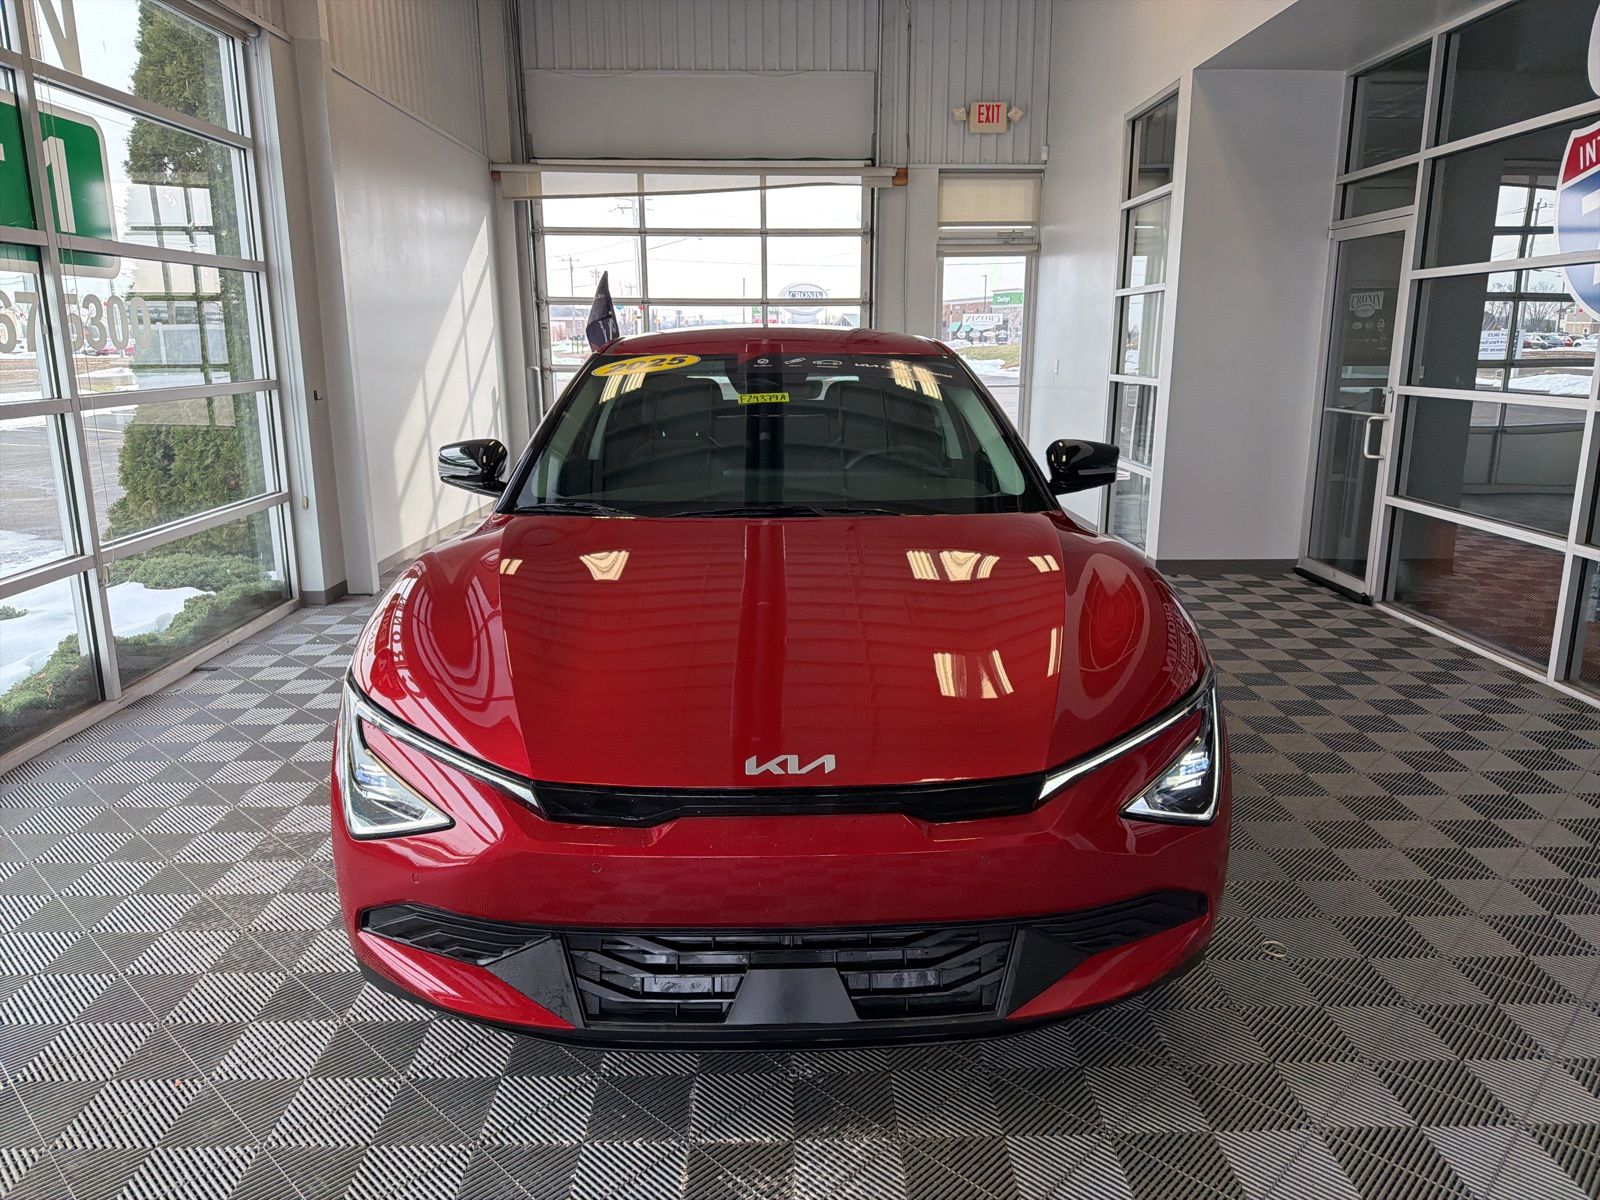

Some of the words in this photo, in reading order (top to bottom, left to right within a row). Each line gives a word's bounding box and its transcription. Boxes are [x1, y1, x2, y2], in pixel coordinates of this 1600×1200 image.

[977, 104, 1001, 123] EXIT
[603, 355, 688, 375] 2025
[745, 754, 836, 776] KIA
